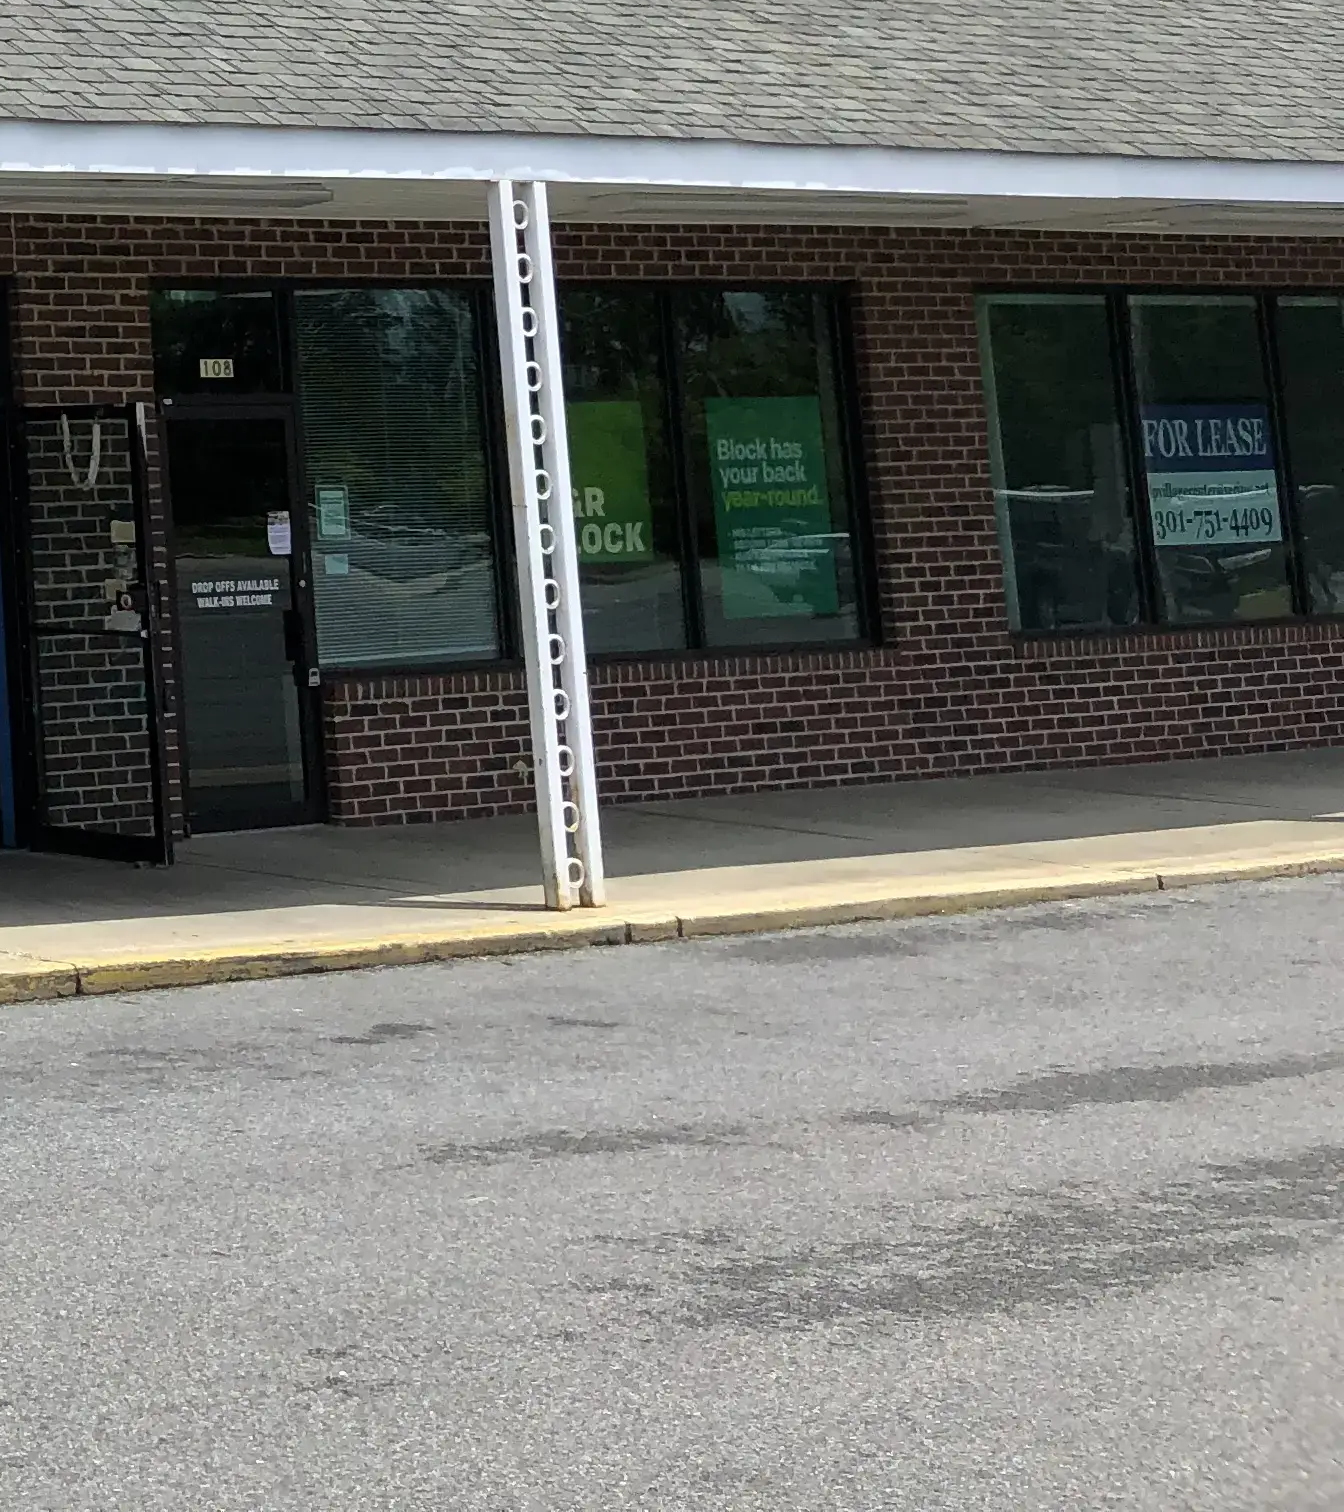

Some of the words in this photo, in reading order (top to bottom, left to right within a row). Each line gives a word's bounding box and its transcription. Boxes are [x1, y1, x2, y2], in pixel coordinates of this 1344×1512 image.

[203, 360, 232, 376] 108
[716, 439, 767, 461] Block
[770, 438, 803, 460] has
[1142, 419, 1193, 458] FOR
[1195, 418, 1267, 457] LEASE
[720, 466, 758, 488] your
[763, 461, 807, 482] back
[1154, 507, 1273, 540] 301-751-4409
[192, 581, 214, 594] DROP
[215, 580, 235, 592] OFFS
[236, 578, 280, 592] AVAILABLE
[196, 595, 234, 608] WALK-INS
[235, 594, 273, 607] WELCOME
